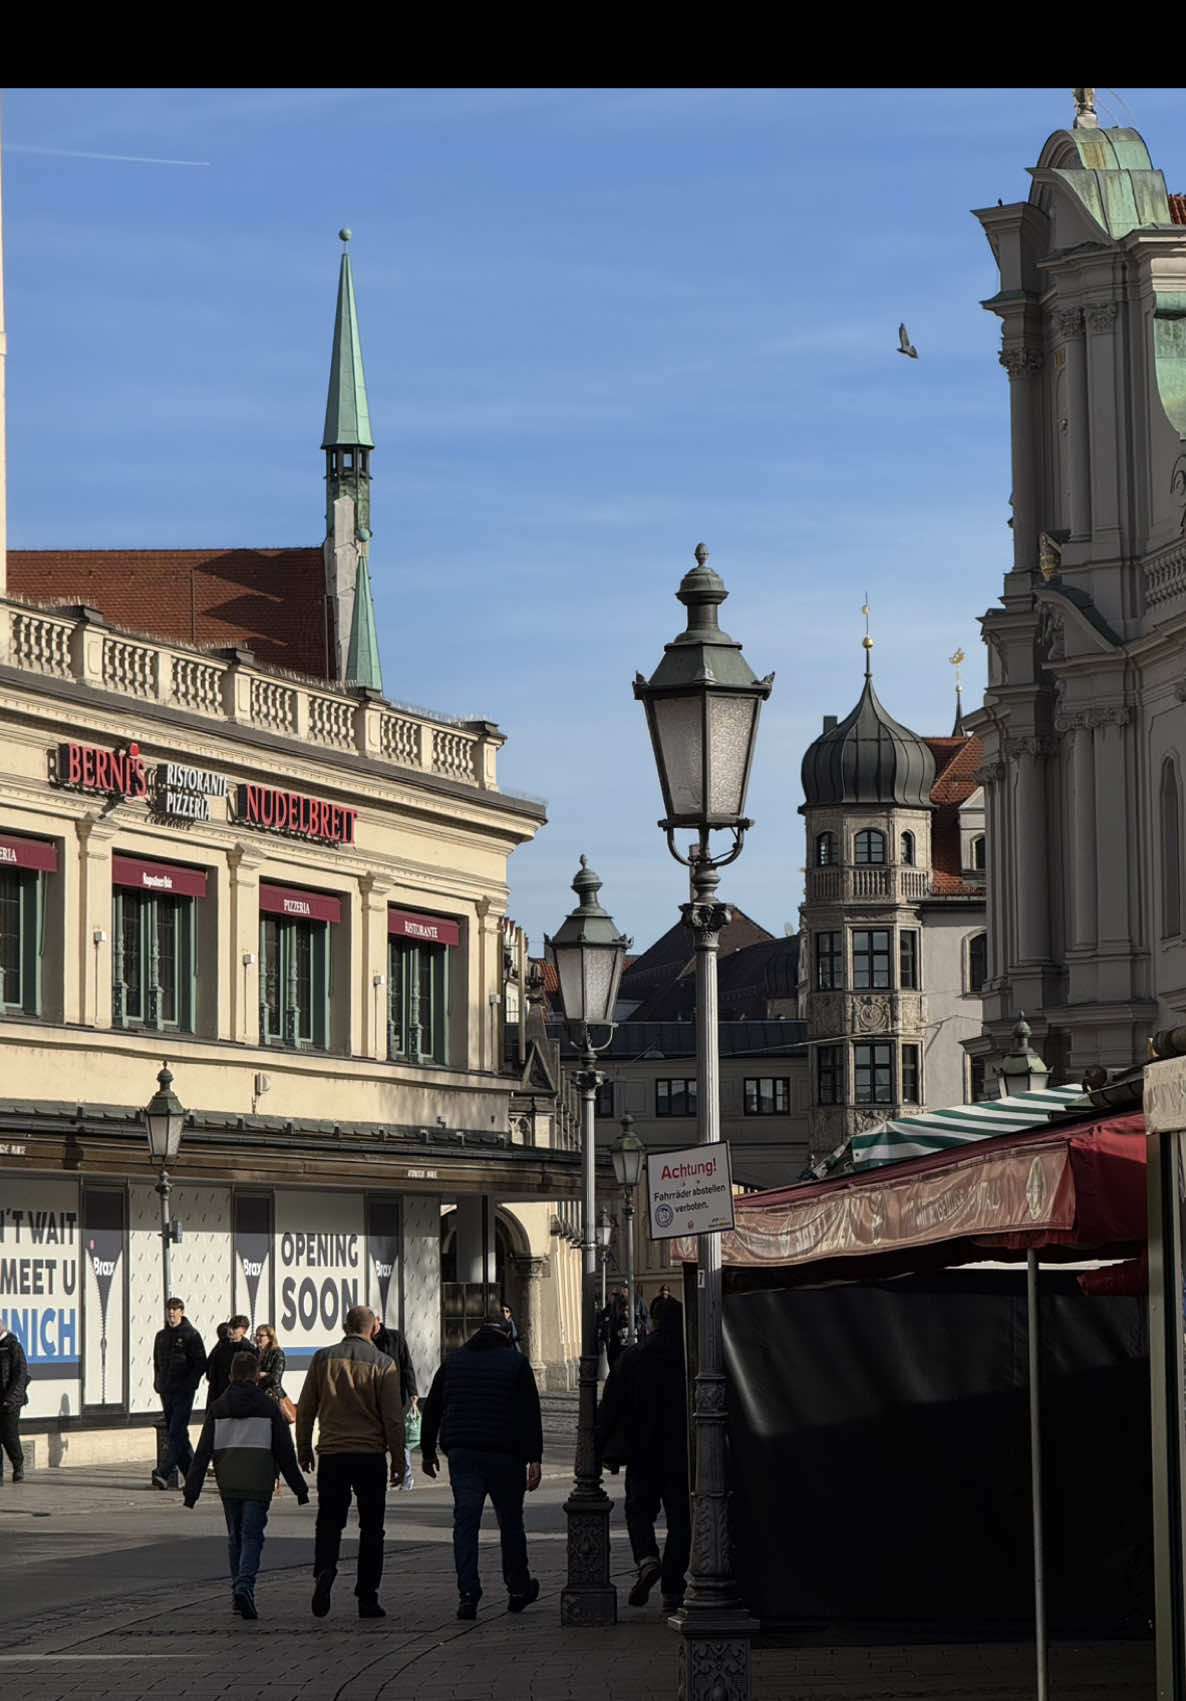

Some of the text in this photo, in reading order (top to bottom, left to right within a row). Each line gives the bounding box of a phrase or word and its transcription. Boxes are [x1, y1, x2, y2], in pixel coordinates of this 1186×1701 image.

[166, 793, 210, 821] PIZZERIA
[246, 784, 358, 844] NUDELBRETT
[283, 900, 311, 915] PIZZERIA
[404, 921, 439, 938] RISTORANTE
[661, 1158, 717, 1180] Achtung!
[693, 1184, 726, 1196] abstellen
[27, 1211, 77, 1245] WAIT
[281, 1232, 358, 1268] OPENING
[63, 1259, 76, 1296] U
[93, 1257, 116, 1276] Brax
[243, 1259, 262, 1276] Brax
[376, 1260, 392, 1278] Brax
[281, 1276, 358, 1332] SOON
